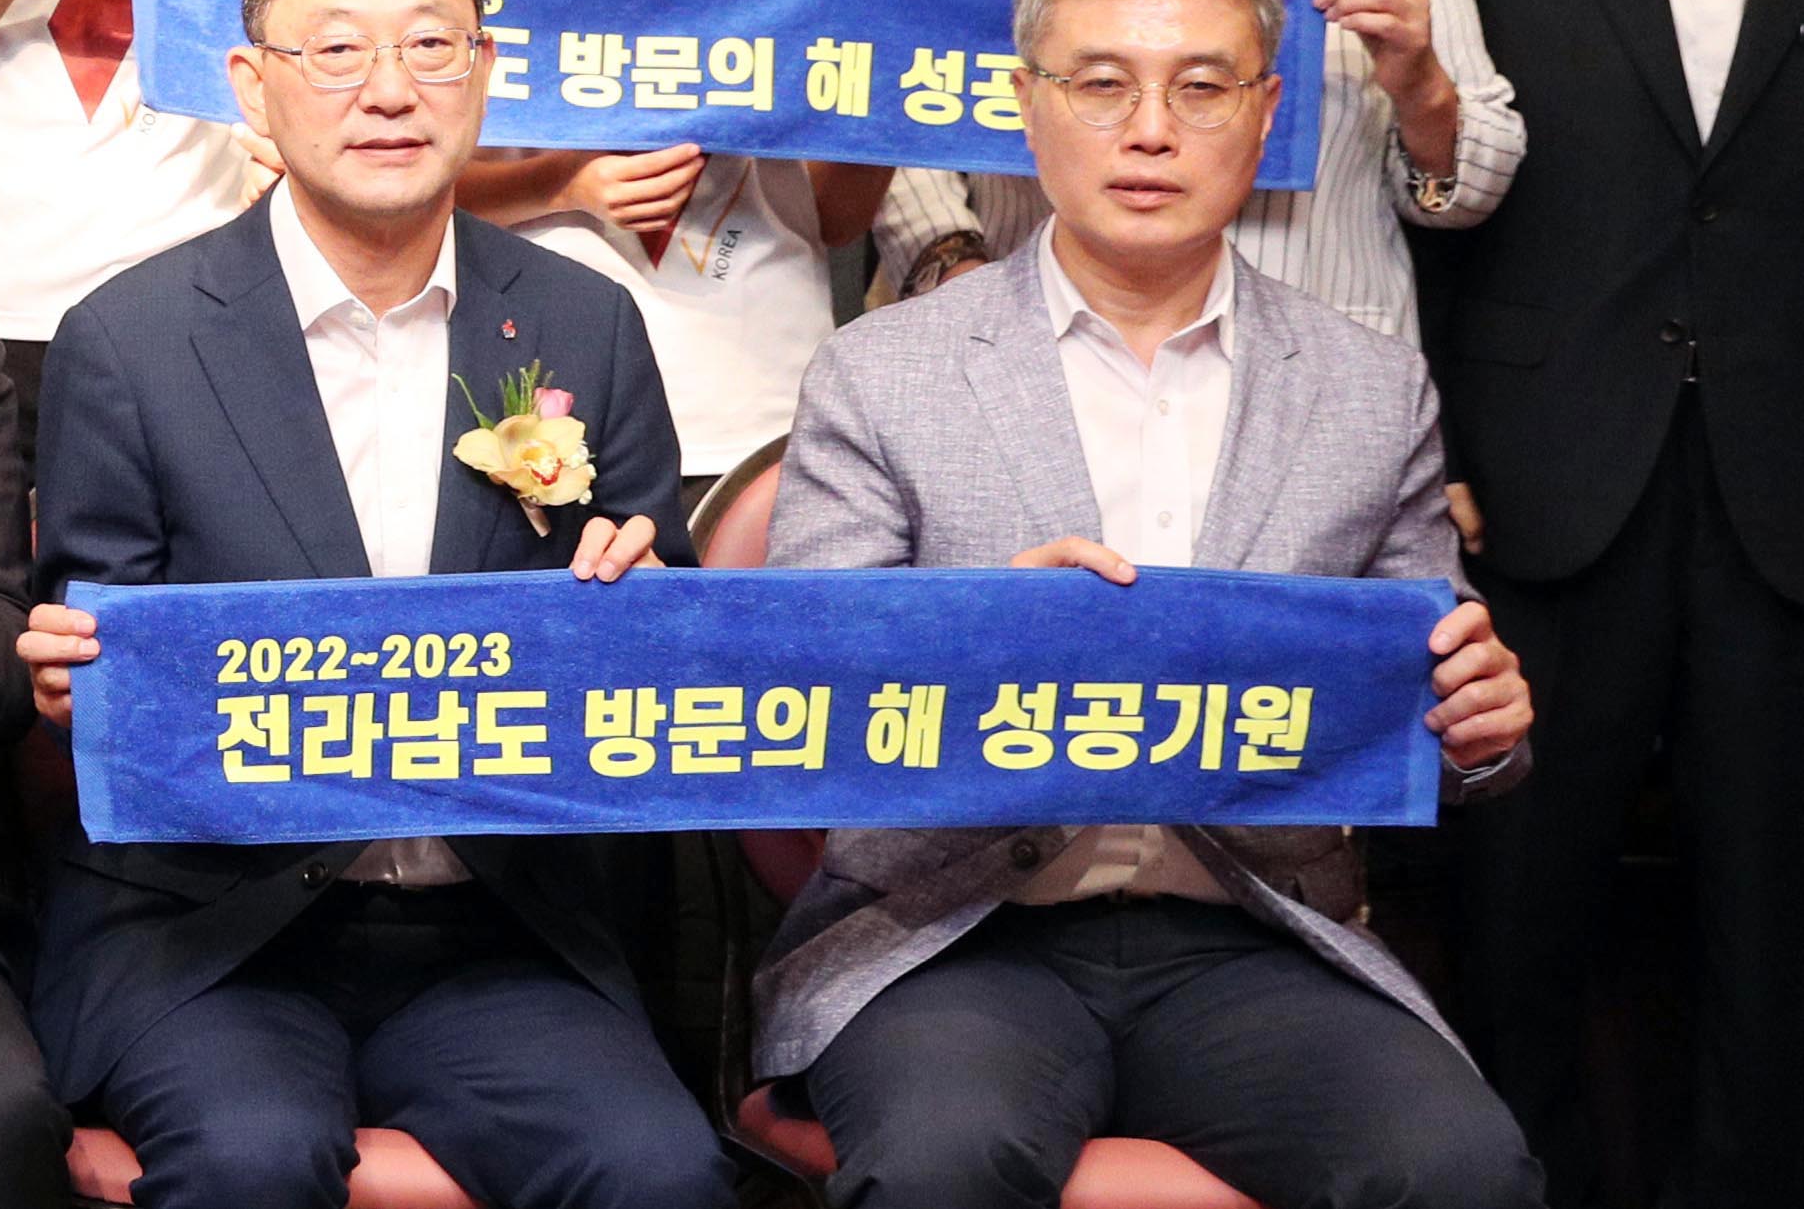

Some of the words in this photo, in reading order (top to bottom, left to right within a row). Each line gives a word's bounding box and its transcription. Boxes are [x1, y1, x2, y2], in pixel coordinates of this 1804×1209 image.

[559, 32, 774, 111] 방문의
[806, 37, 872, 117] 해
[711, 228, 742, 281] KOREA
[217, 632, 510, 683] 2022~2023
[217, 691, 551, 783] 전라남도
[585, 686, 830, 773] 방문의
[866, 683, 942, 769] 해
[978, 683, 1313, 772] 성공기원
